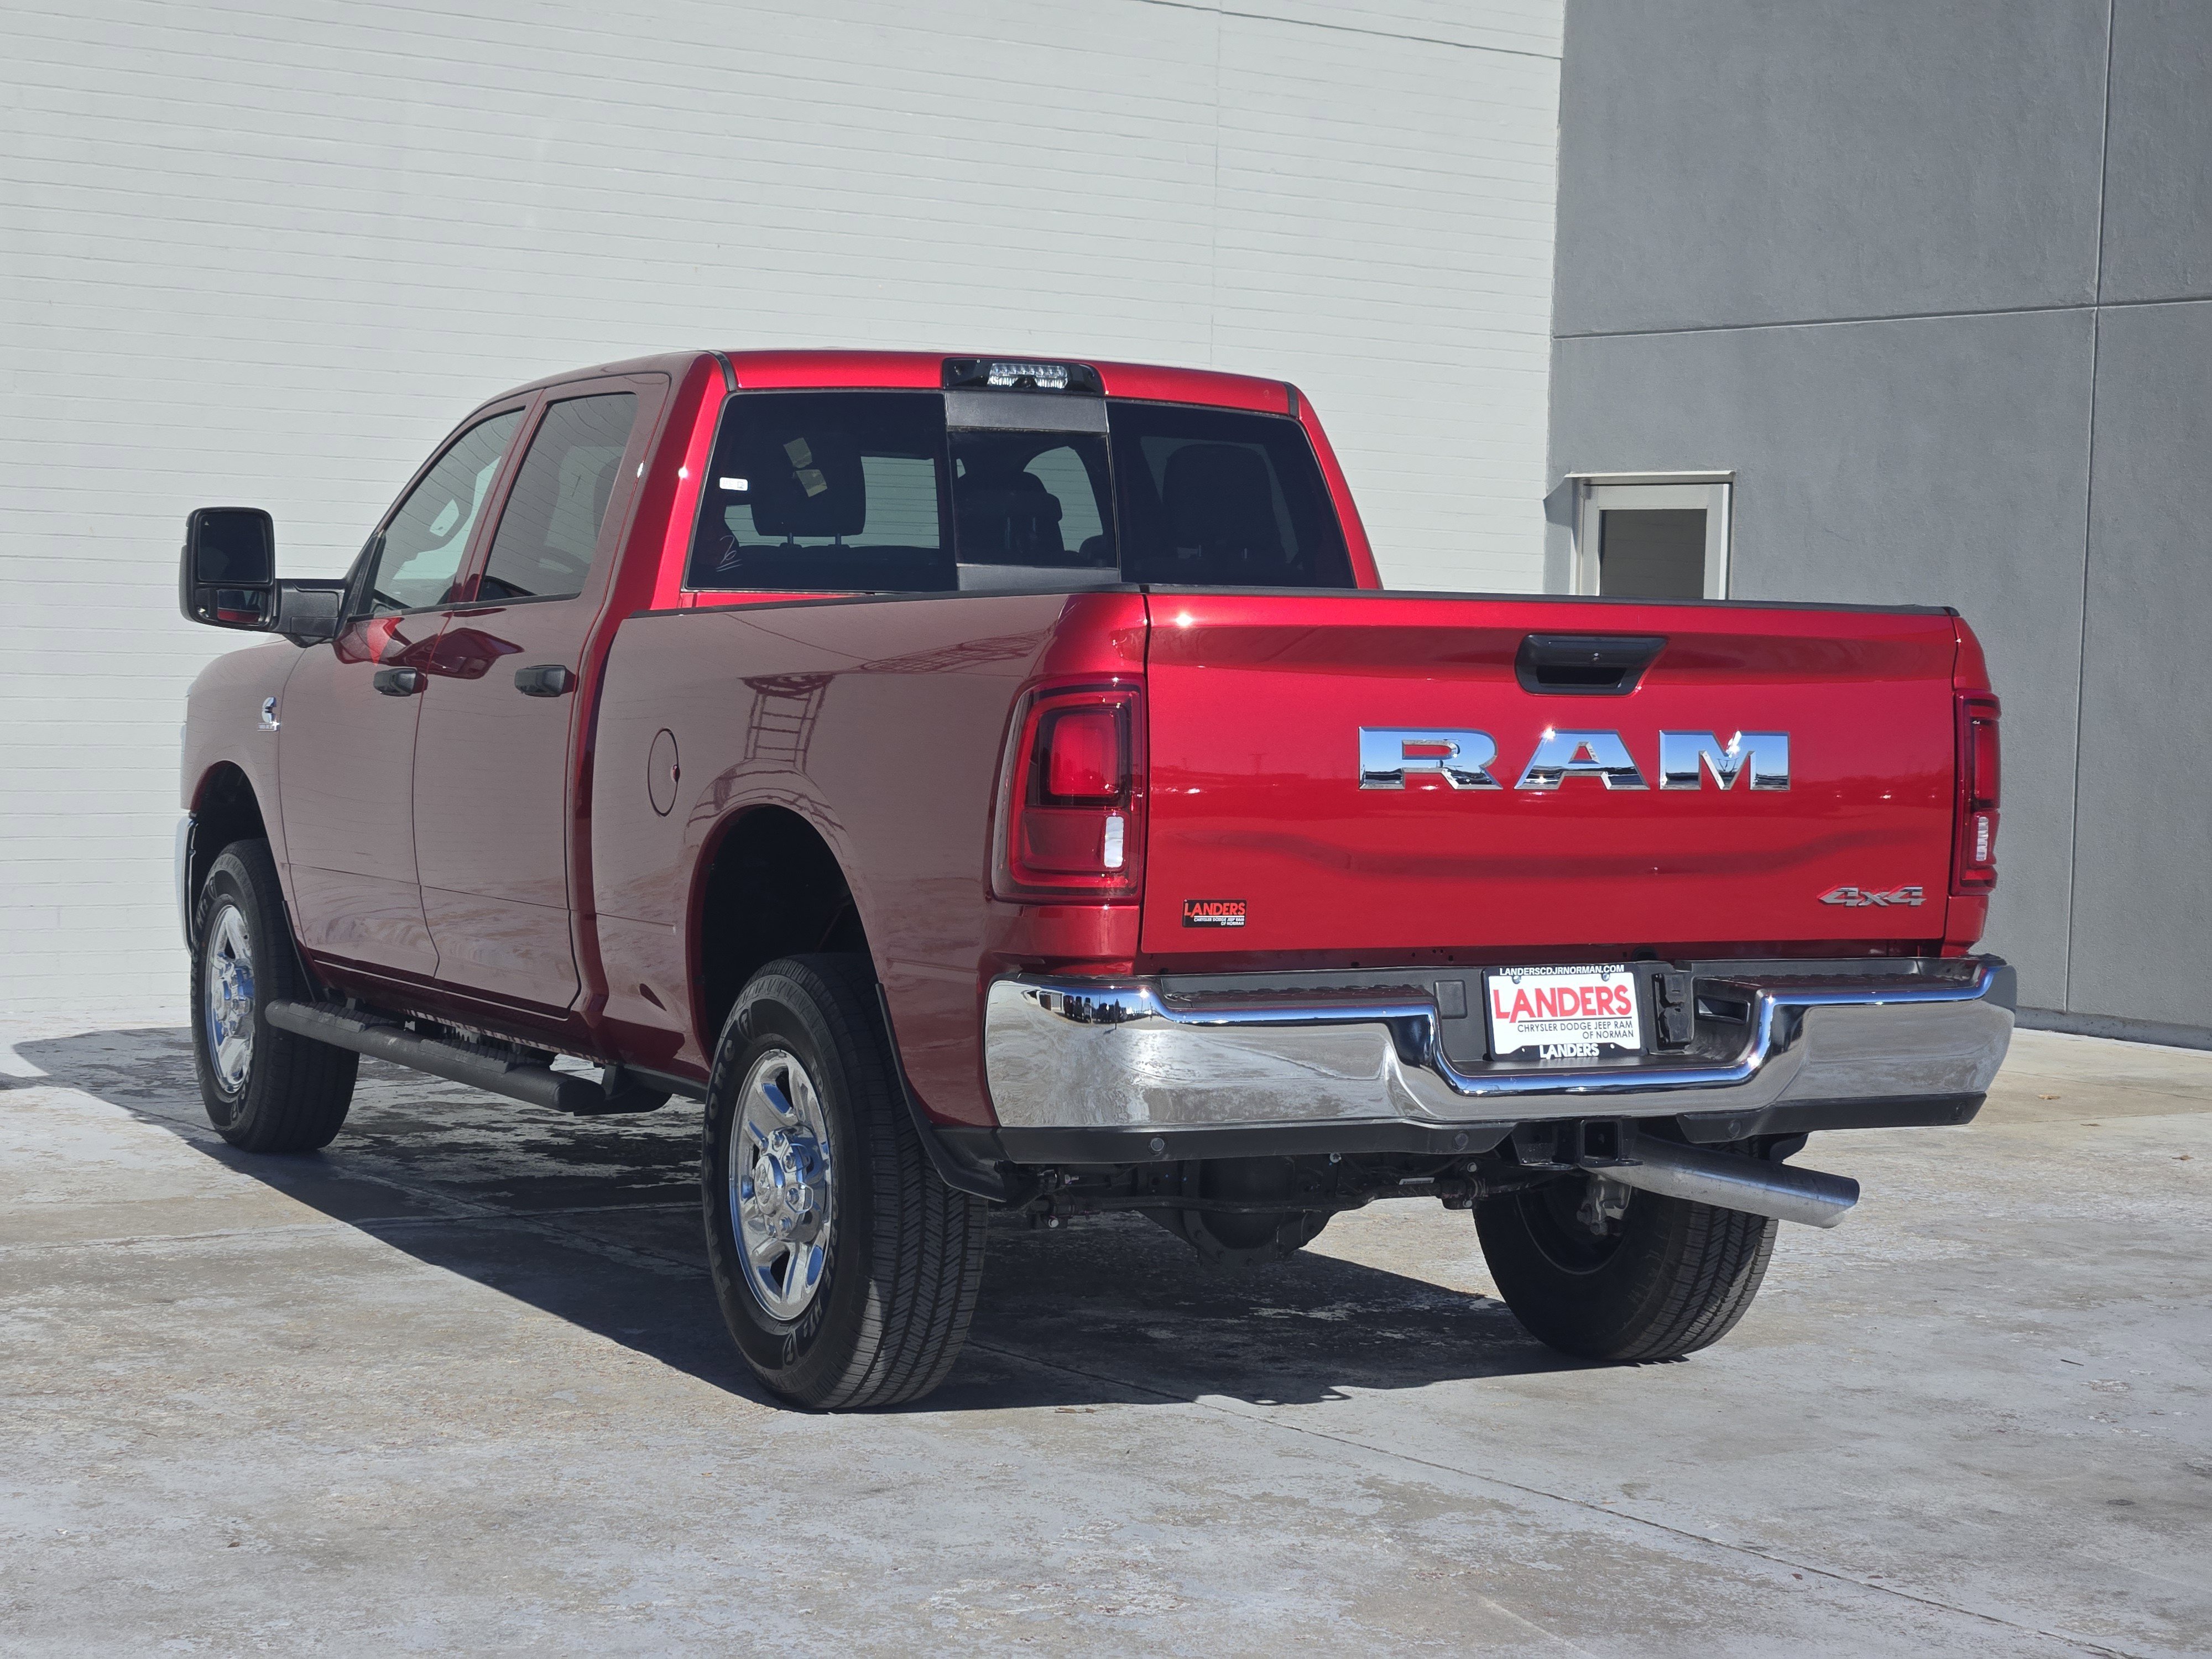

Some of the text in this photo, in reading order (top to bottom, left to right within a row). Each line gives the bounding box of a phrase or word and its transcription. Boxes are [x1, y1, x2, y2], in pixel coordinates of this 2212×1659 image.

[1358, 727, 1791, 791] RAM
[1184, 902, 1245, 917] LANDERS
[1499, 964, 1625, 976] LANDERSCDJRNORMAN.COM
[1493, 985, 1632, 1023] LANDERS
[1517, 1020, 1633, 1032] CHRYSLER DODGE JEEP RAM
[1596, 1030, 1634, 1039] NORMAN
[1539, 1042, 1600, 1060] LANDERS
